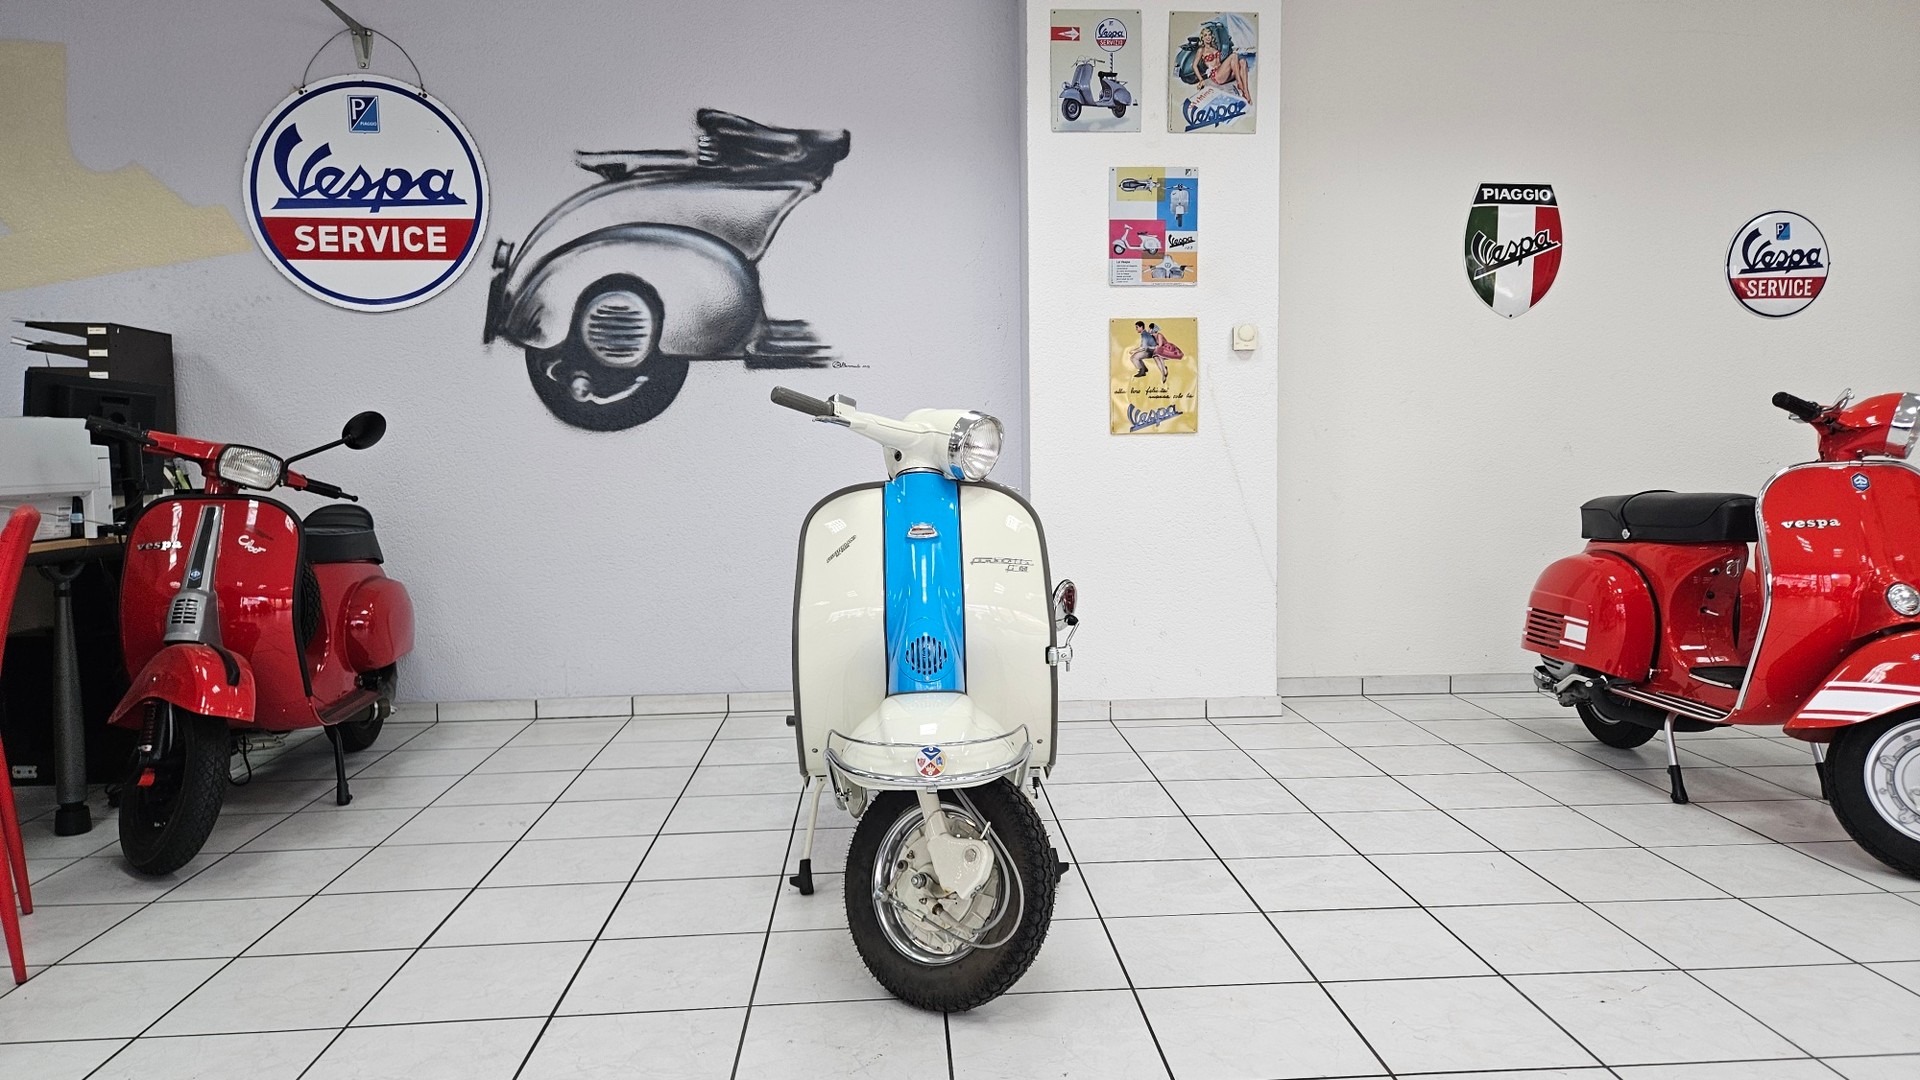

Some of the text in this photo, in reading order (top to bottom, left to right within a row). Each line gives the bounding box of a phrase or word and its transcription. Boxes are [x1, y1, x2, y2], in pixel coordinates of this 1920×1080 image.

[1098, 23, 1125, 39] Vespa
[351, 98, 366, 120] P
[1183, 97, 1247, 132] Vespa
[271, 122, 468, 213] Vespa
[1481, 187, 1552, 201] PIAGGIO
[294, 225, 448, 254] SERVICE
[1738, 227, 1825, 274] Vespa
[1471, 229, 1562, 281] Vespa
[1746, 279, 1813, 298] SERVICE
[1127, 403, 1183, 433] Vespa
[1781, 518, 1841, 529] vespa
[137, 540, 183, 551] vespa
